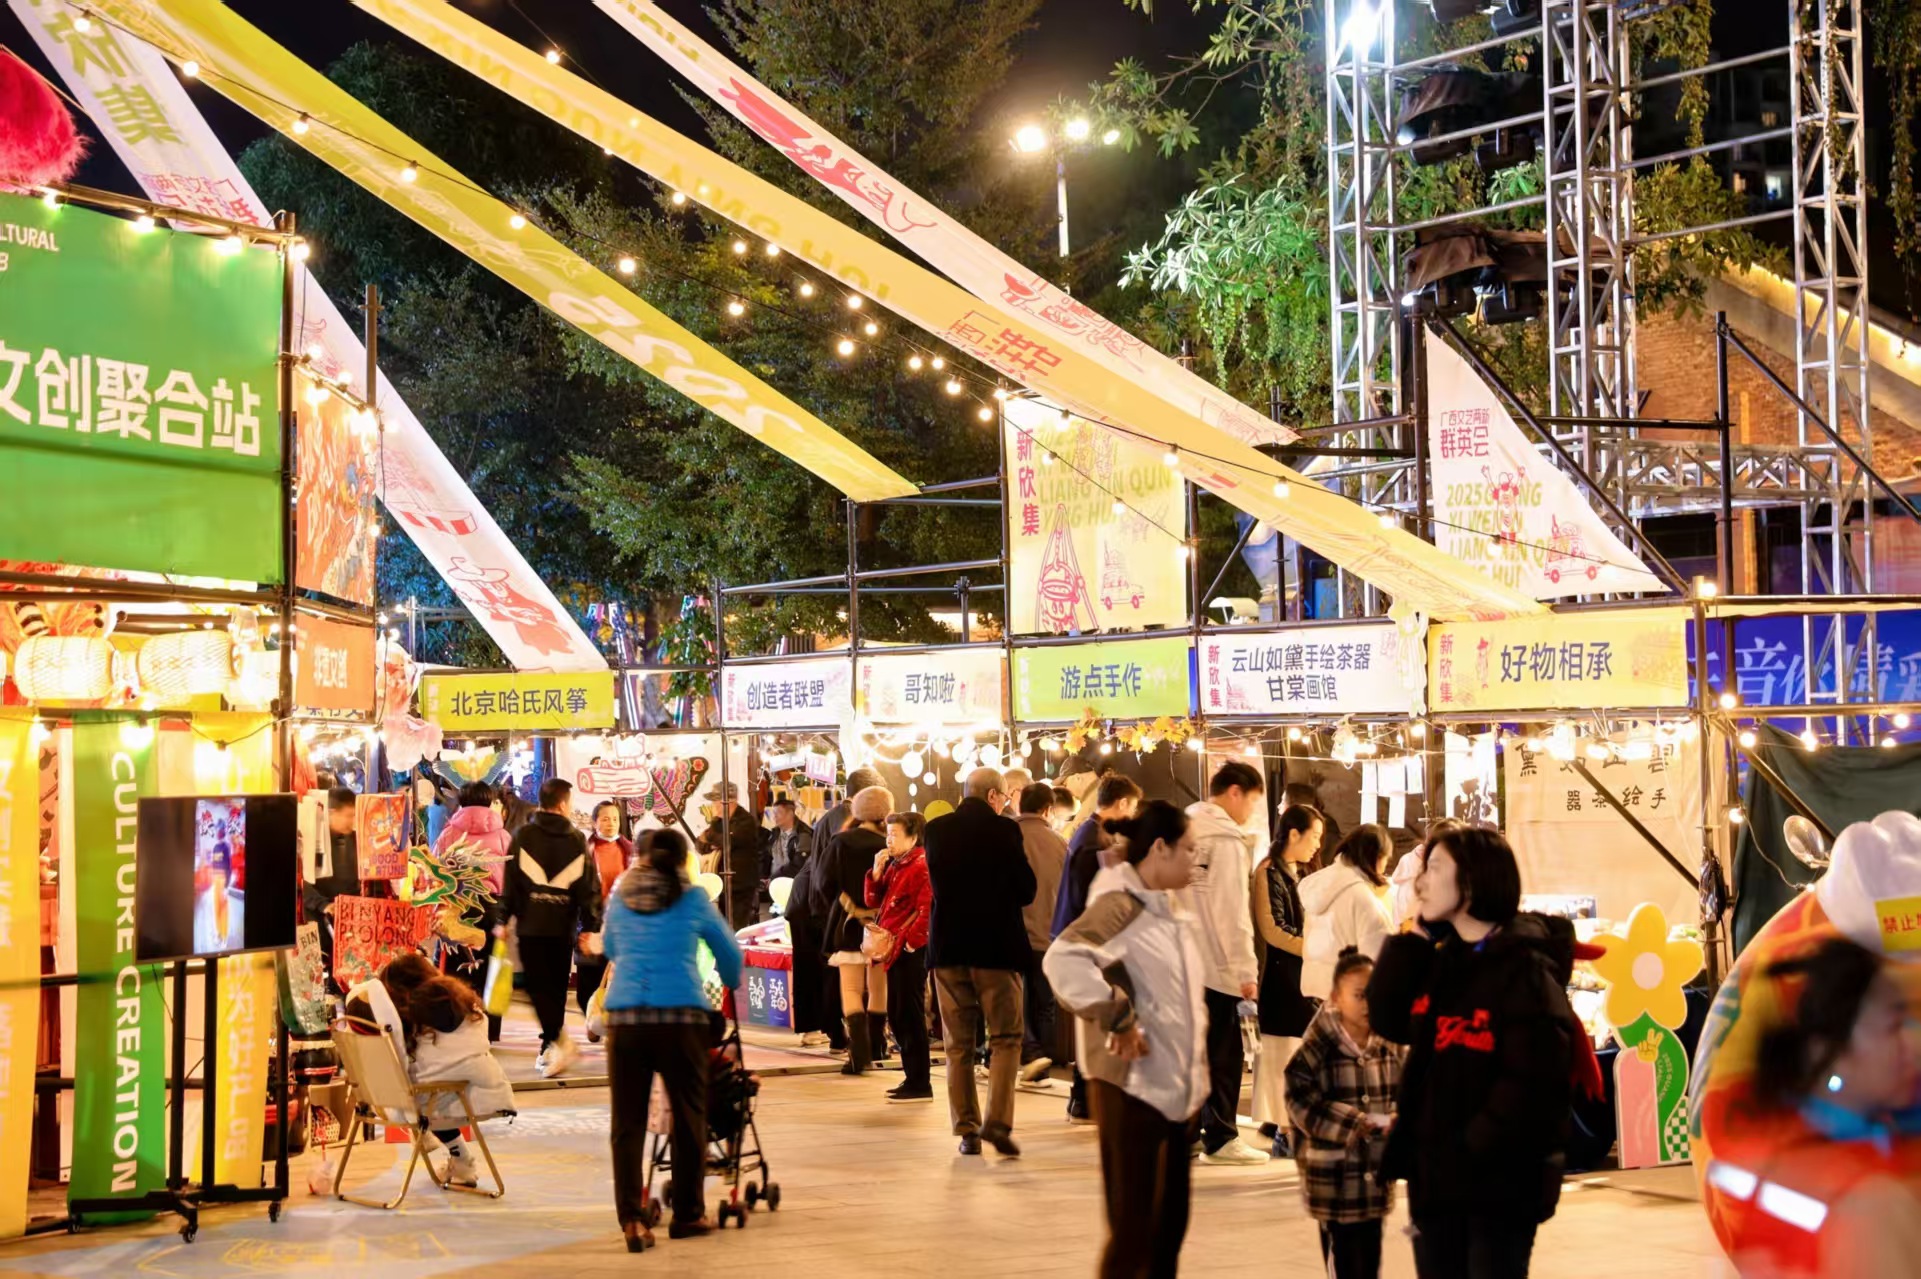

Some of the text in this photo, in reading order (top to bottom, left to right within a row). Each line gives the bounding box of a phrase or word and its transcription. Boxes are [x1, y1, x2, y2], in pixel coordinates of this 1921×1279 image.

[0, 339, 261, 457] 文创聚合站
[1440, 408, 1490, 428] 广西文艺两新
[1440, 426, 1489, 459] 群英会
[1016, 428, 1040, 537] 新欣集
[1130, 464, 1172, 498] QUN
[1446, 481, 1543, 507] 2025GNG
[1231, 643, 1371, 673] 云山如黛手绘茶器
[1440, 633, 1453, 704] 新欣集
[1500, 640, 1613, 683] 好物相承
[904, 672, 956, 705] 哥知啦
[1060, 662, 1142, 700] 游点手作
[1207, 644, 1222, 708] 新欣集
[1266, 674, 1338, 702] 甘棠画馆
[450, 687, 589, 717] 北京哈氏风筝
[746, 679, 825, 711] 创造者联盟
[363, 864, 408, 877] FRTUNE
[340, 902, 417, 925] BINYANG
[109, 751, 142, 1194] CULTURE CREATION
